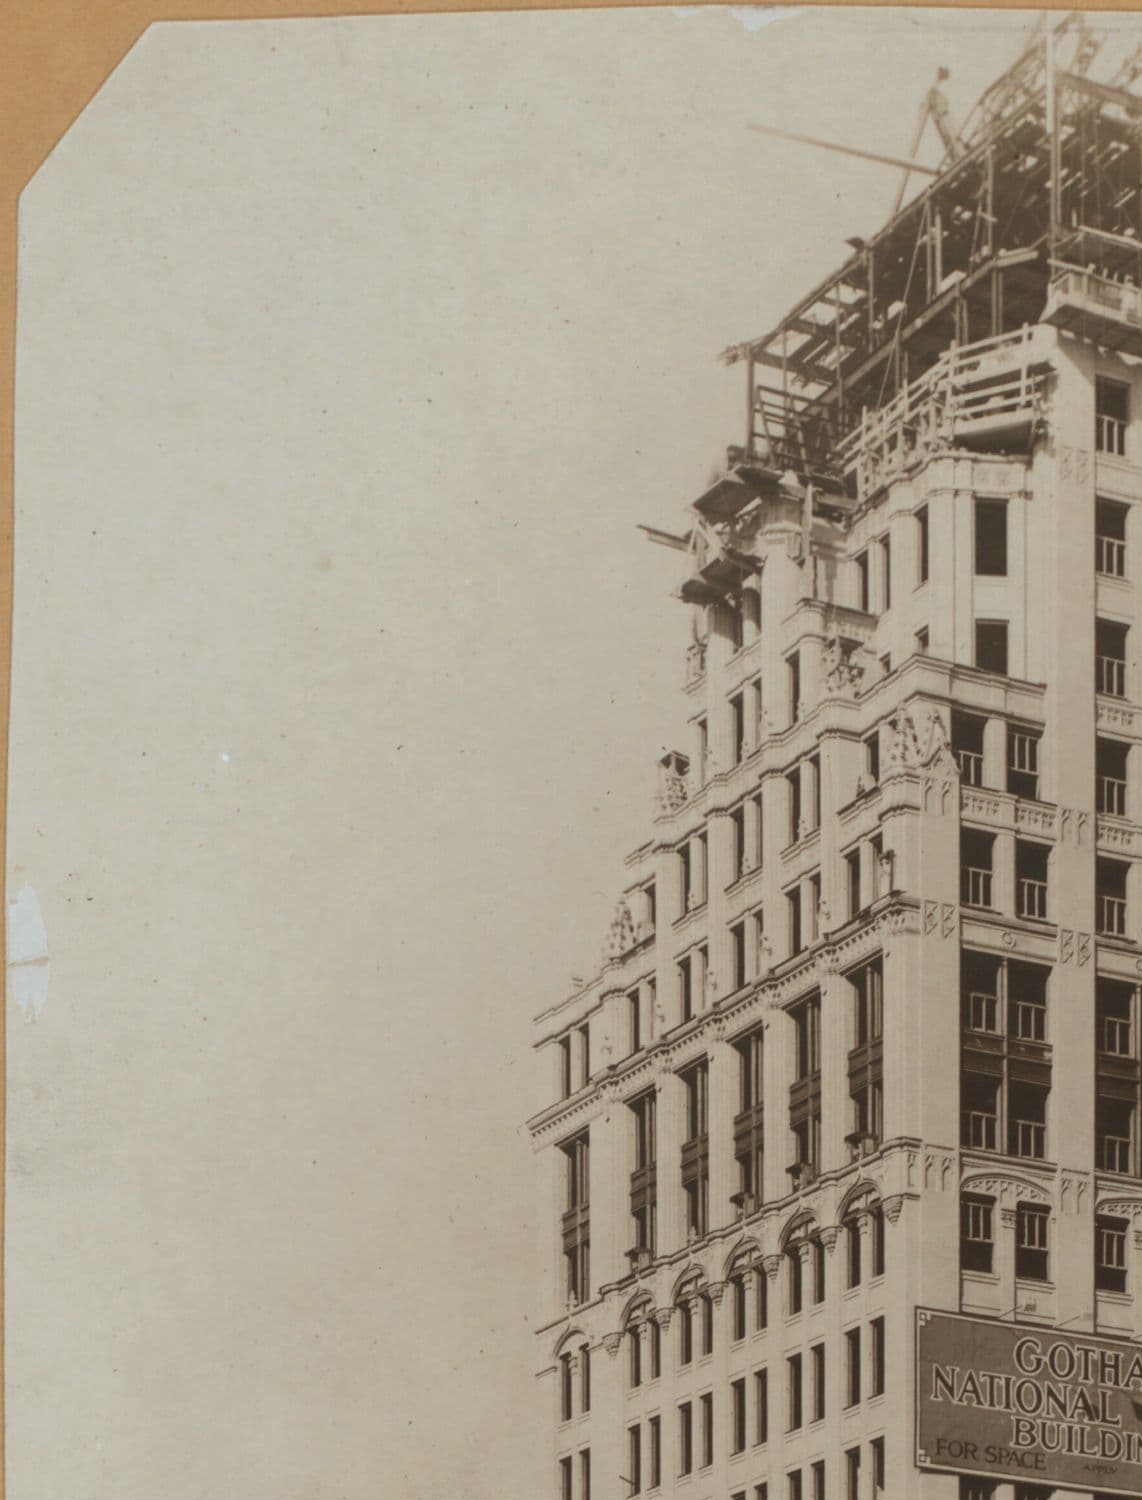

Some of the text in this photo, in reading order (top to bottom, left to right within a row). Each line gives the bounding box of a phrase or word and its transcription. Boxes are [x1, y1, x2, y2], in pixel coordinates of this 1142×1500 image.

[931, 1363, 1121, 1427] NATIONAL
[935, 1437, 979, 1462] FOR
[985, 1443, 1047, 1471] SPACE
[1082, 1463, 1118, 1475] APPLY
